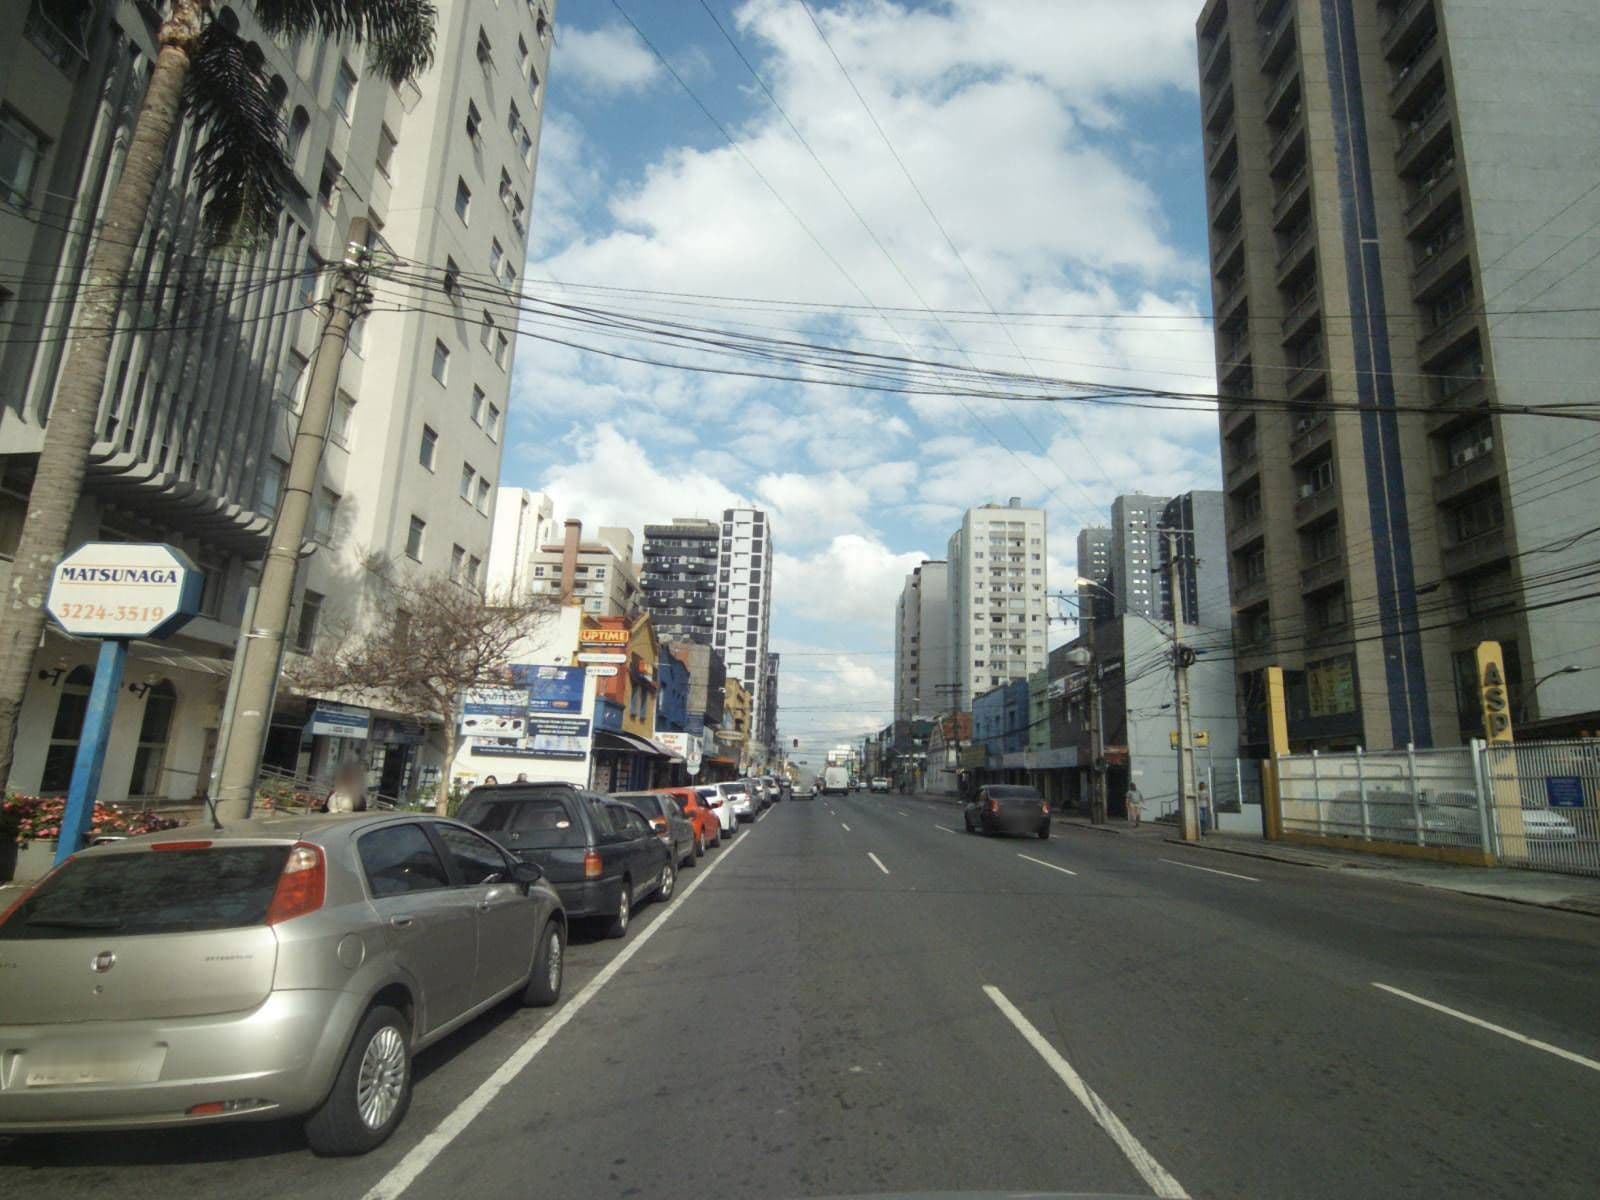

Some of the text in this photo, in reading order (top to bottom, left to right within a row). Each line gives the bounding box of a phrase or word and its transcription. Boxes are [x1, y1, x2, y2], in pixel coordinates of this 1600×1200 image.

[61, 567, 177, 584] MATSUNAGA
[59, 603, 165, 622] 3224-3519
[582, 631, 626, 641] UPTIME
